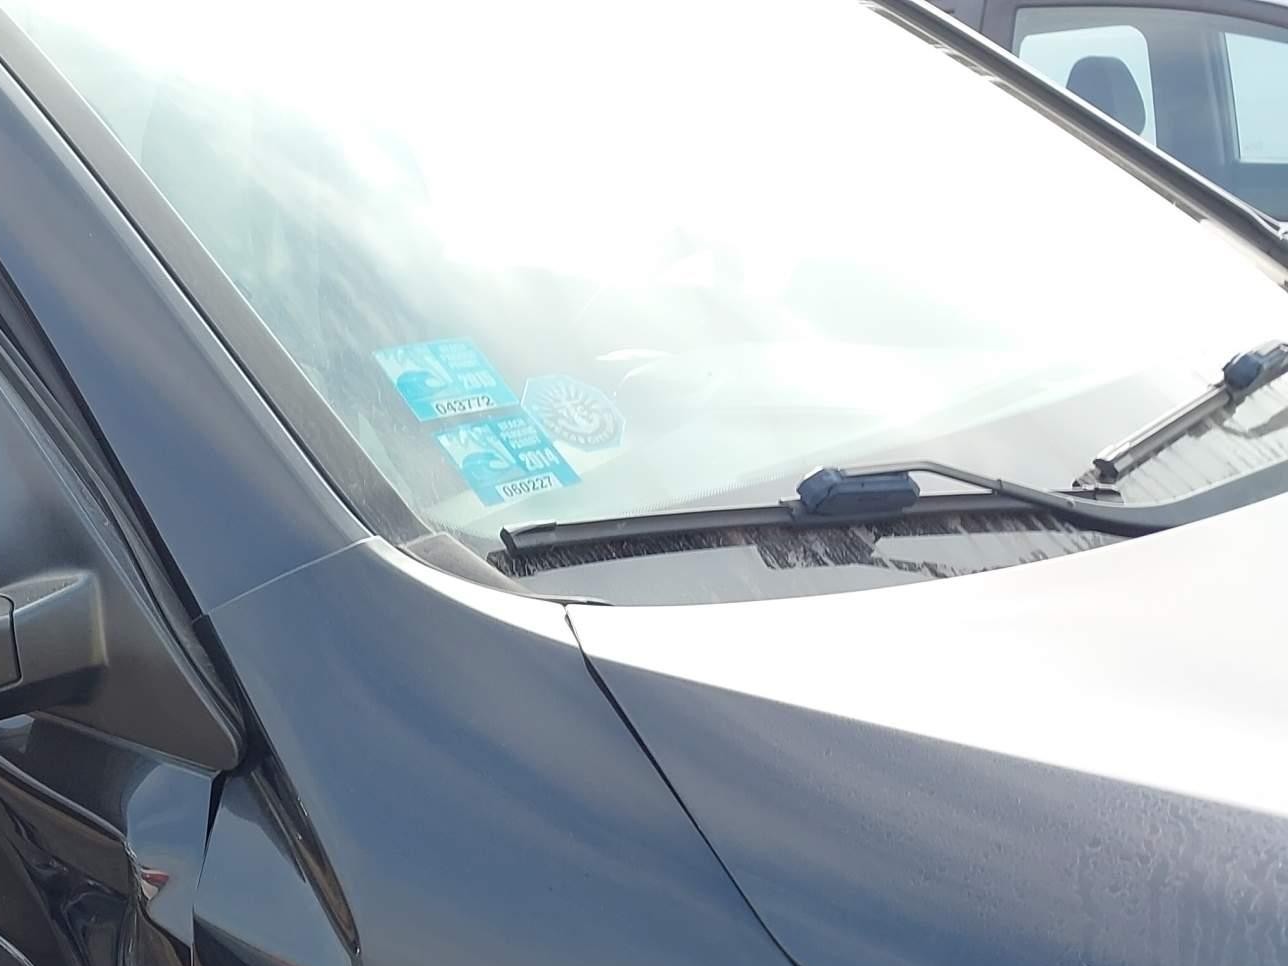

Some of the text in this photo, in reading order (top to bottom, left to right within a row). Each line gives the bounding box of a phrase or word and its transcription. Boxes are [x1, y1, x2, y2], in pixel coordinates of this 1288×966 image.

[435, 395, 495, 416] 043772
[518, 447, 560, 471] 2014
[502, 475, 553, 498] 060227
